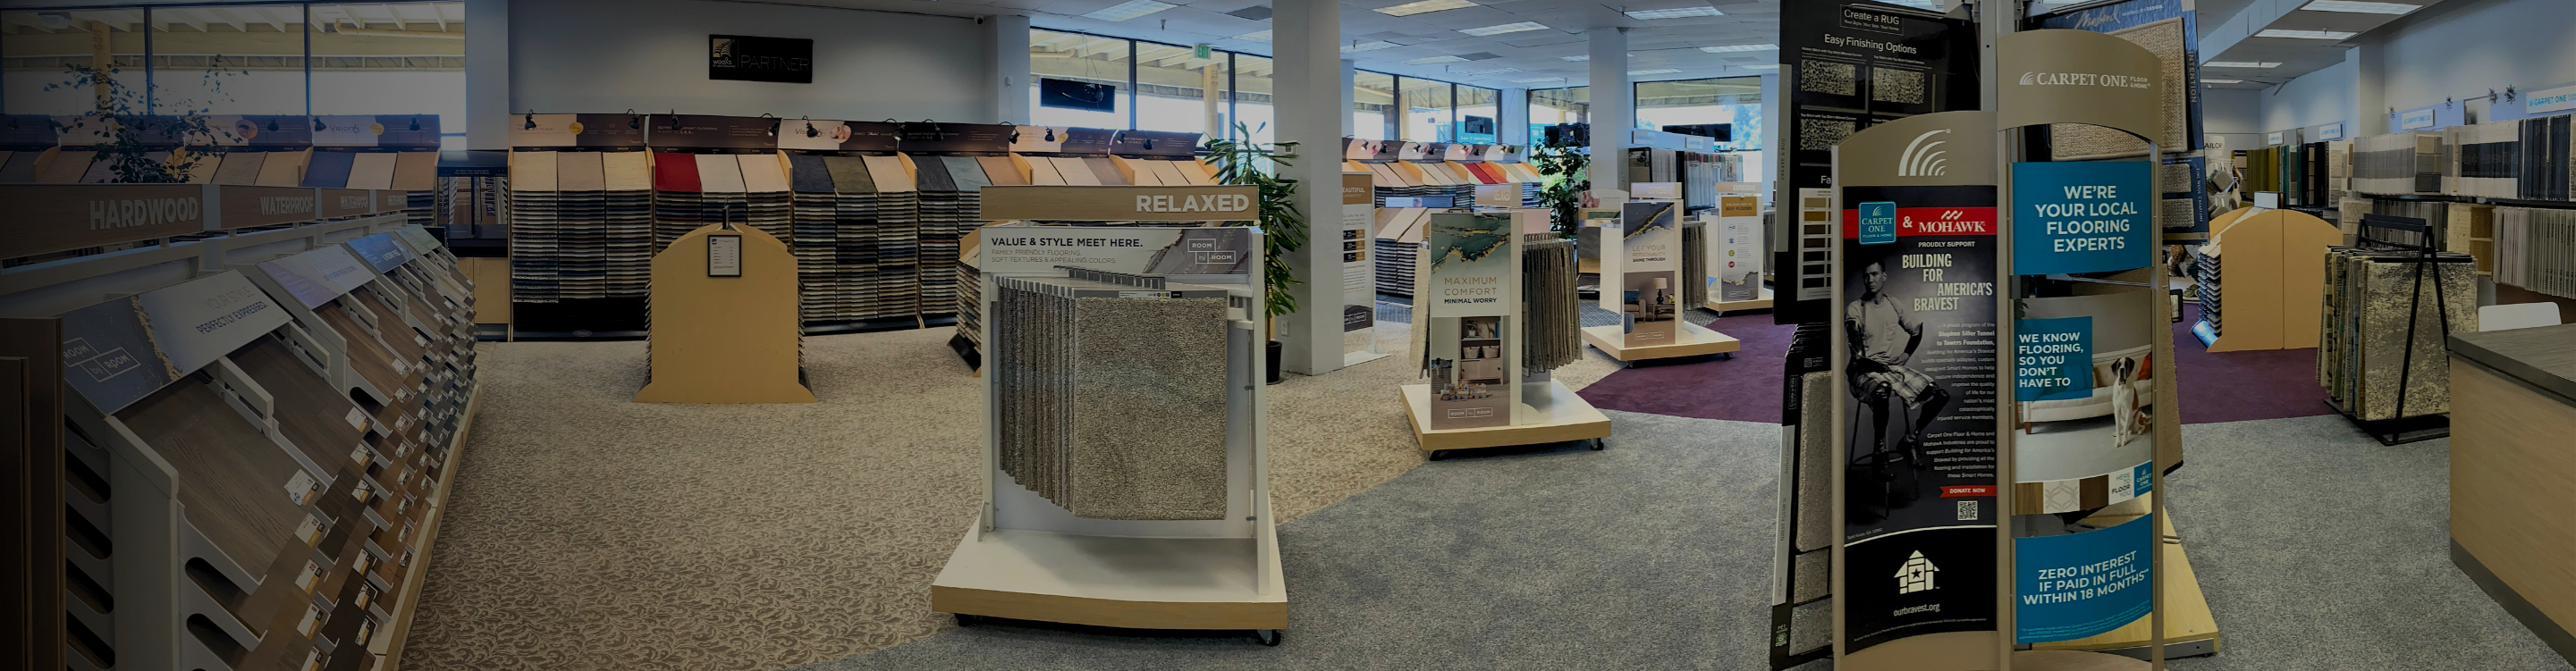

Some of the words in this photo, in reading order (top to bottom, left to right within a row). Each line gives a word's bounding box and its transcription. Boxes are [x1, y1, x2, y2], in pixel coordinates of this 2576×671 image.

[1845, 9, 1871, 21] Create
[1881, 15, 1899, 24] RUG
[1825, 34, 1845, 46] Easy
[1846, 37, 1883, 51] Finishing
[1886, 42, 1916, 54] Options
[1198, 46, 1210, 58] EXIT
[713, 57, 732, 65] wools
[741, 55, 810, 71] PARTNER
[2037, 72, 2097, 86] CARPET
[2100, 75, 2128, 87] ONE
[2189, 52, 2197, 103] INTENTION
[2555, 95, 2566, 103] ONE
[2064, 186, 2117, 199] WE'RE
[260, 196, 313, 215] WATERPROOF
[340, 196, 369, 210] WATERPROOF
[1136, 195, 1250, 213] RELAXED
[2034, 204, 2085, 217] YOUR
[2090, 202, 2138, 216] LOCAL
[89, 197, 198, 231] HARDWOOD
[1903, 216, 1913, 228] &
[1919, 222, 1985, 232] MOHAWK
[2047, 219, 2130, 234] FLOORING
[992, 238, 1026, 246] VALUE
[1029, 238, 1036, 246] &
[1040, 238, 1073, 247] STYLE
[1077, 239, 1106, 247] MEET
[1110, 239, 1143, 247] HERE.
[2054, 237, 2124, 252] EXPERTS
[1902, 254, 1952, 268] BUILDING
[1444, 277, 1497, 285] MAXIMUM
[1923, 269, 1943, 282] FOR
[1444, 288, 1497, 296] COMFORT
[1938, 282, 1992, 296] AMERICA'S
[202, 295, 230, 310] YOUR
[231, 286, 255, 304] STYLE
[1913, 298, 1959, 311] BRAVEST
[195, 313, 235, 334] PERFECTLY
[232, 301, 268, 321] EXPRESSED.
[2019, 334, 2039, 343] WE
[2042, 332, 2081, 342] KNOW
[63, 345, 89, 359] ROOM
[2019, 343, 2083, 354] FLOORING,
[104, 355, 130, 369] ROOM
[2019, 356, 2035, 365] SO
[2040, 356, 2065, 365] YOU
[90, 365, 103, 375] by
[2019, 366, 2057, 376] DON'T
[2019, 379, 2052, 388] HAVE
[2055, 377, 2071, 387] TO
[2116, 473, 2130, 481] HERE
[2137, 474, 2151, 482] CARPET
[2112, 484, 2131, 494] FLOOR
[2038, 566, 2077, 580] ZERO
[2081, 550, 2137, 576] INTEREST
[2039, 582, 2052, 592] IF
[2057, 577, 2089, 591] PAID
[2093, 574, 2106, 586] IN
[2109, 564, 2136, 582] FULL
[2023, 591, 2077, 605] WITHIN
[2081, 589, 2093, 600] 18
[1894, 603, 1940, 616] ourbravest.org
